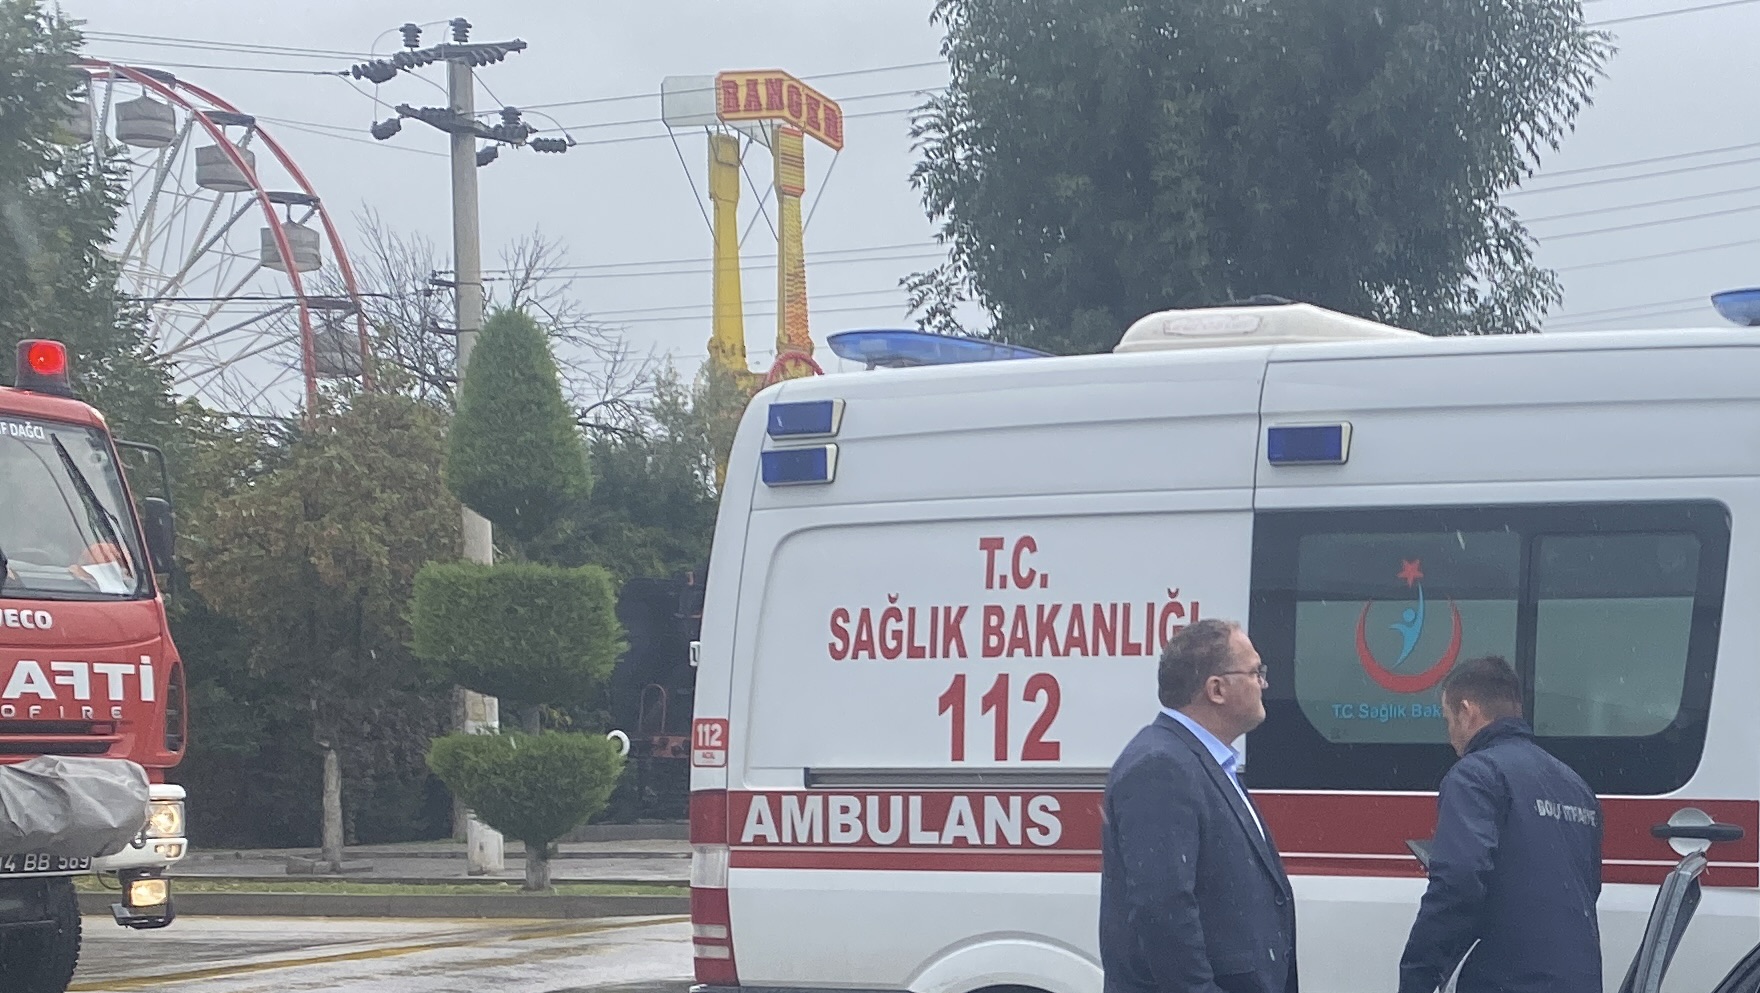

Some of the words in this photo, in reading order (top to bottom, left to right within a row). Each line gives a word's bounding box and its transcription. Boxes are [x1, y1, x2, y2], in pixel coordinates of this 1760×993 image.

[722, 78, 840, 143] RANGER
[980, 536, 1049, 589] T.C.
[829, 593, 968, 660] SAĞLIK
[697, 723, 722, 747] 112
[939, 673, 1061, 762] 112
[1359, 703, 1406, 723] Sağlık
[740, 795, 1062, 846] AMBULANS
[24, 853, 50, 871] BB
